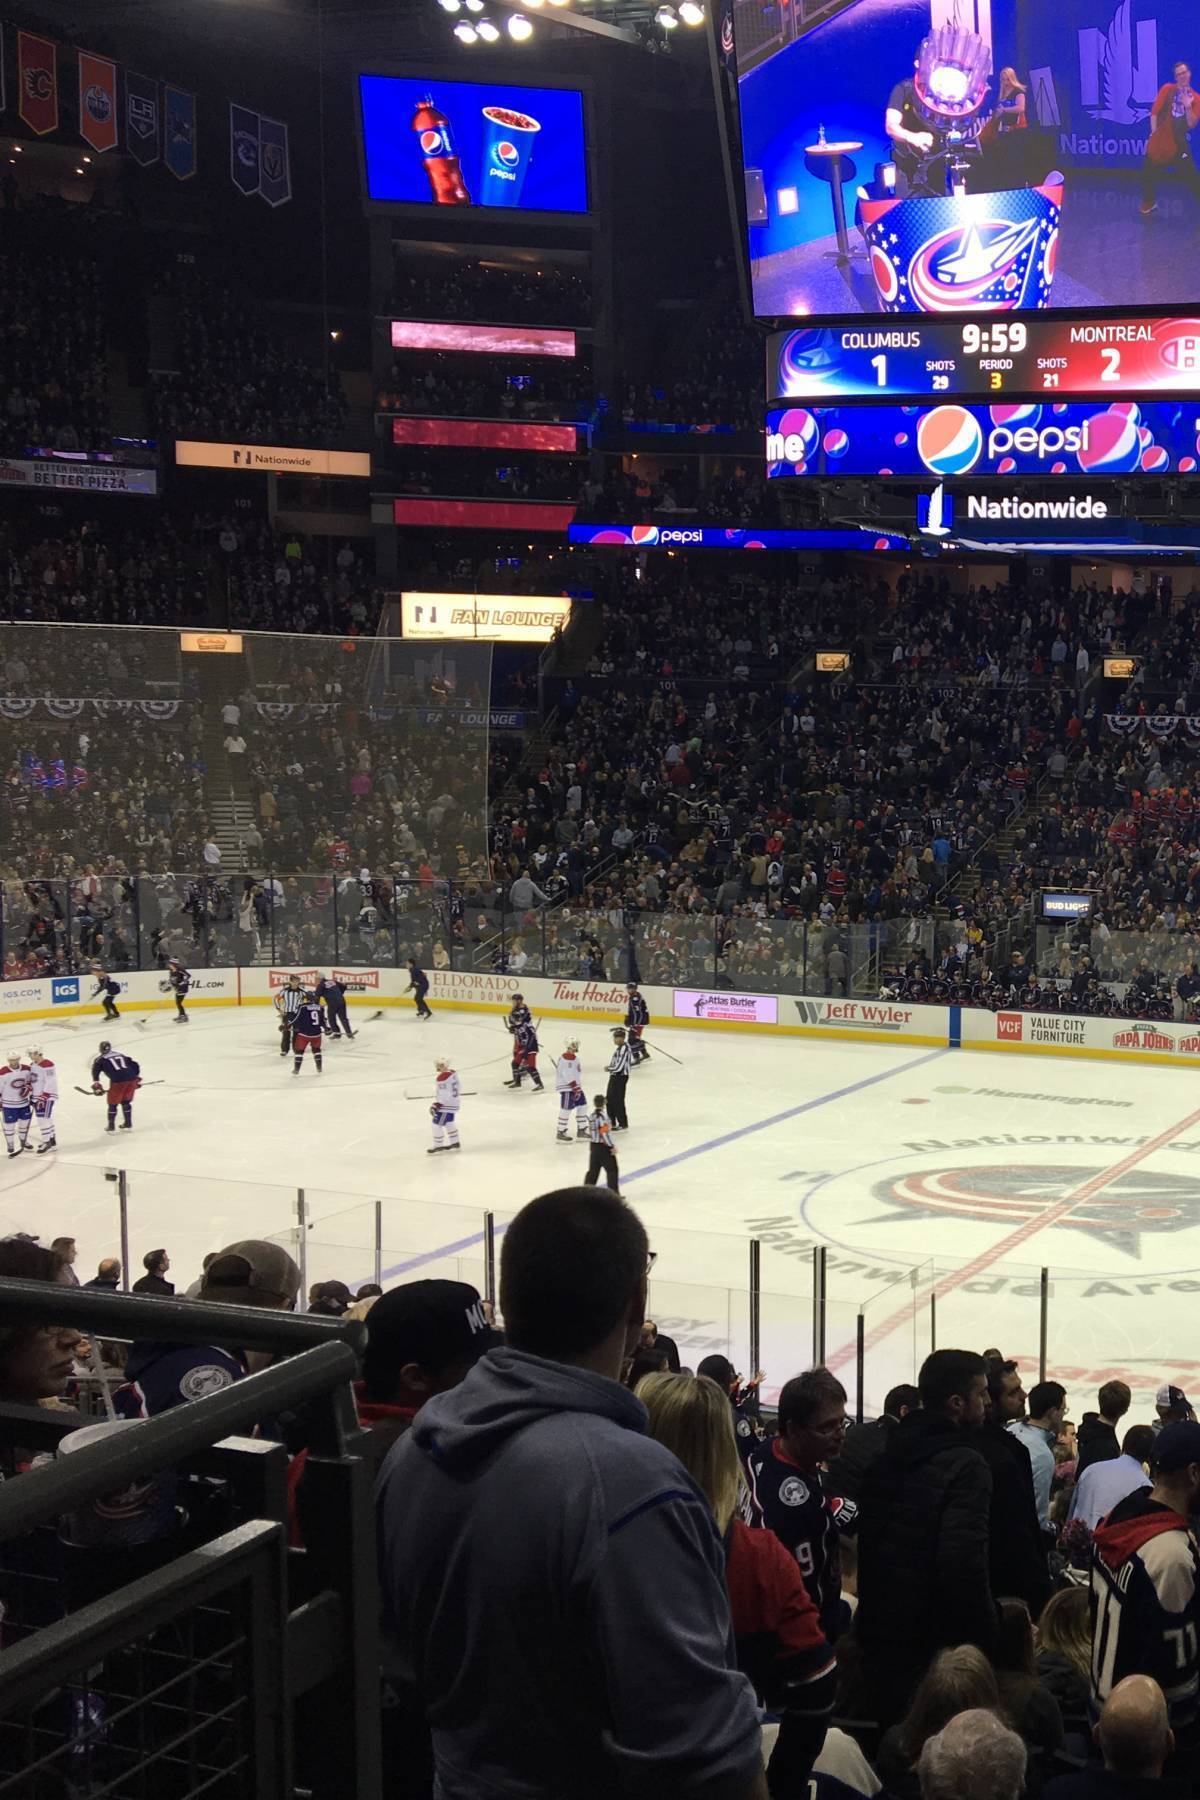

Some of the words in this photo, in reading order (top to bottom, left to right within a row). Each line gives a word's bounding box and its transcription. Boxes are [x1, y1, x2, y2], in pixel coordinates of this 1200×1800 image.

[1060, 133, 1149, 155] Nationw
[490, 167, 516, 181] pepsi
[842, 332, 921, 349] COLUMBUS
[962, 322, 1027, 353] 9:59
[1070, 325, 1156, 343] MONTREAL
[871, 354, 887, 386] 1
[1100, 348, 1121, 381] 2
[926, 361, 955, 373] SHOTS
[979, 359, 1013, 370] PERIOD
[1037, 357, 1068, 369] SHOTS
[932, 375, 949, 389] 29
[990, 373, 1002, 388] 3
[1043, 373, 1059, 387] 21
[989, 420, 1089, 458] pepsi
[255, 454, 312, 466] Nationwide
[34, 472, 84, 487] BETTER
[234, 499, 252, 508] 101
[968, 496, 1107, 519] Nationwide
[661, 529, 703, 544] pepsi
[451, 609, 489, 625] FAN
[492, 611, 564, 626] LOUNGE
[660, 681, 676, 690] 101
[938, 689, 954, 698] 102
[460, 713, 517, 725] LOUNGE
[433, 973, 520, 991] ELDORADO
[55, 985, 77, 997] IGS
[433, 987, 473, 1000] SCIOTO
[553, 981, 579, 1001] Tim
[708, 995, 729, 1006] Atlas
[730, 997, 757, 1008] Butler
[311, 1011, 319, 1026] 9
[826, 1003, 859, 1020] Jeff
[861, 1004, 912, 1025] Wyler
[999, 1020, 1022, 1032] VCF
[1031, 1017, 1060, 1031] VALUE
[1063, 1019, 1086, 1031] CITY
[1031, 1029, 1085, 1044] FURNITURE
[1115, 1031, 1139, 1048] PAPA
[973, 1087, 1135, 1109] Huntington
[1163, 1621, 1198, 1670] 71
